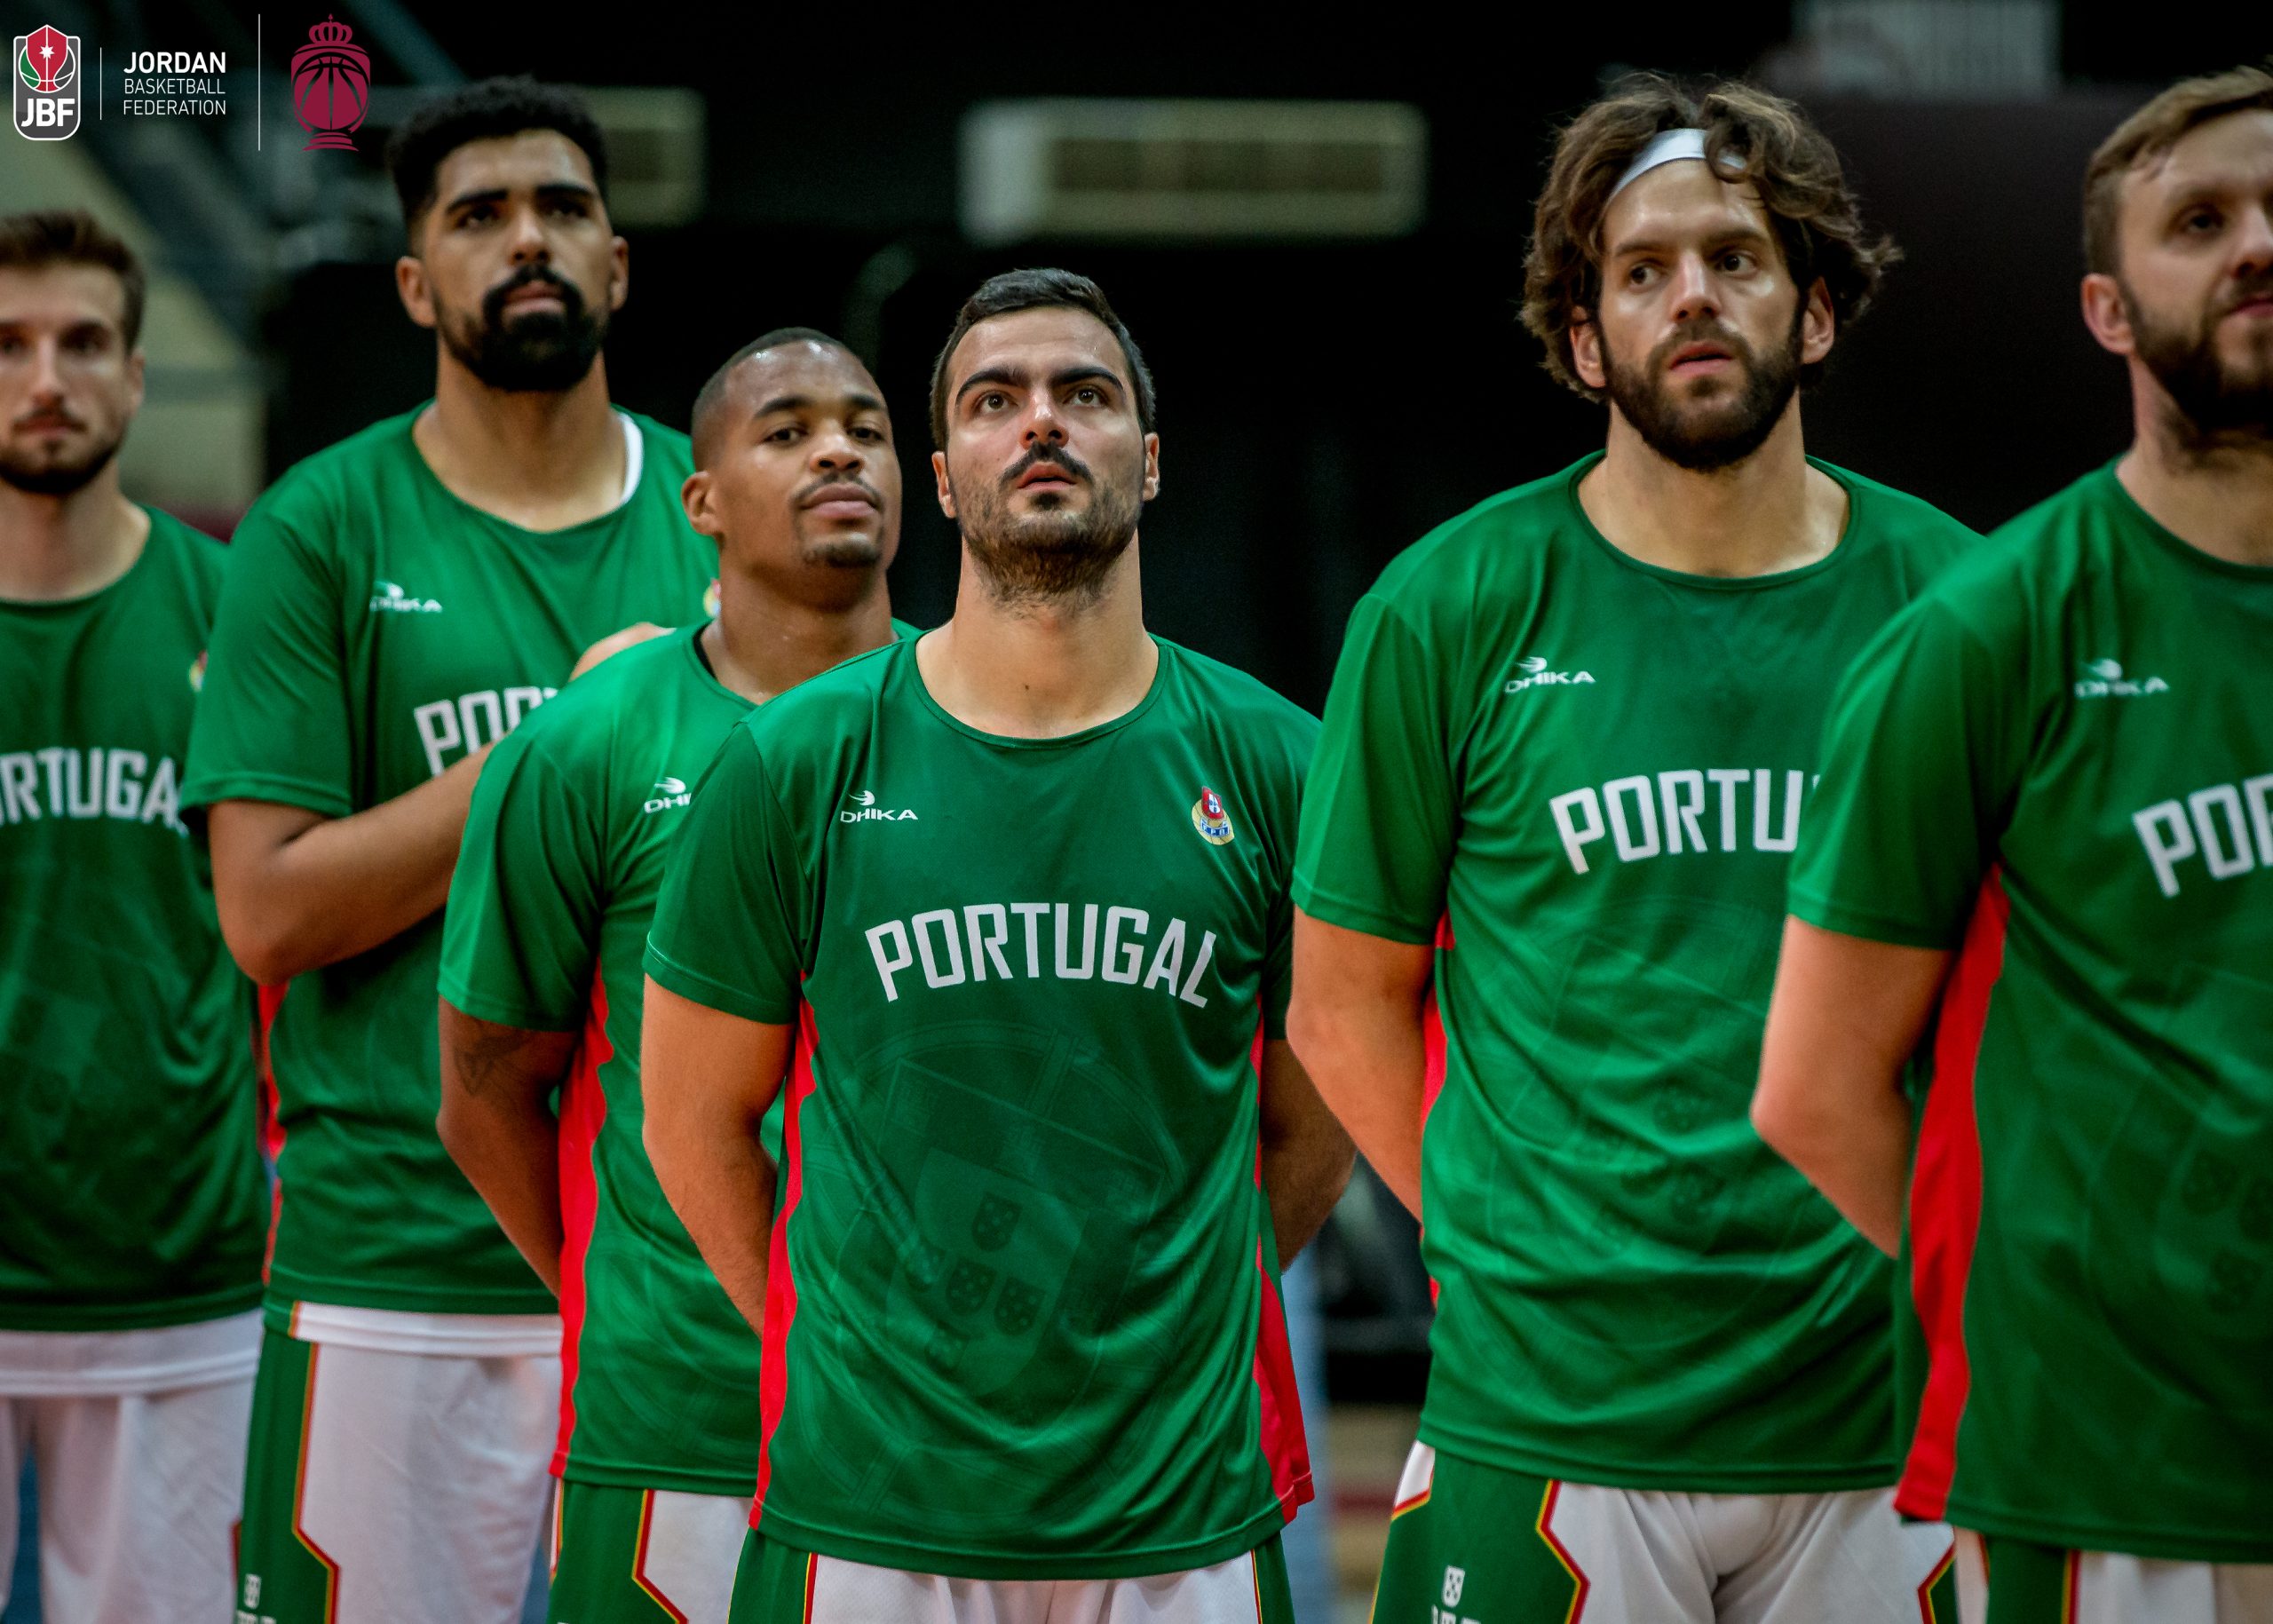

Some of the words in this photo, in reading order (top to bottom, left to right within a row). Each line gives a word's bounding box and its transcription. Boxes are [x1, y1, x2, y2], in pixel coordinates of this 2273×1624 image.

[1505, 670, 1596, 693] DHIKA
[413, 685, 558, 778] PO
[0, 747, 189, 838] RTUGA
[840, 808, 919, 823] DHIKA
[1548, 768, 1820, 875] PORTU
[865, 902, 1216, 1009] PORTUGAL
